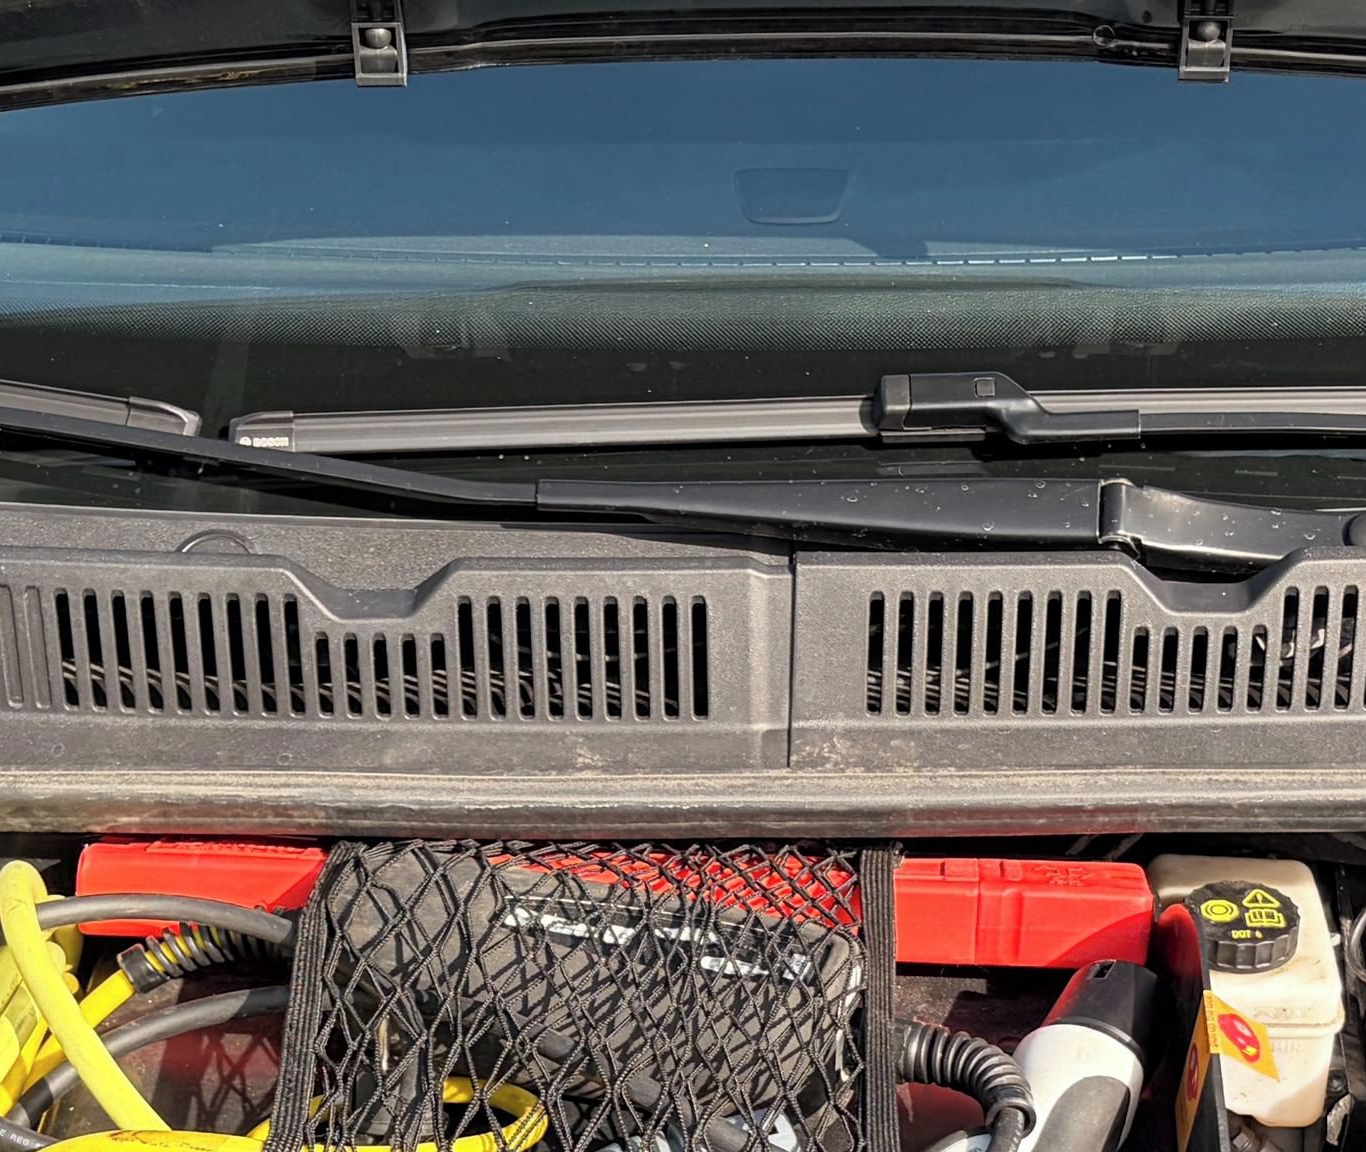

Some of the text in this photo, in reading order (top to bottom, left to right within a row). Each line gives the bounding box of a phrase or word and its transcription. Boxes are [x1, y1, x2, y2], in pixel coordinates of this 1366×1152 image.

[252, 436, 290, 448] BOSCH
[1231, 929, 1251, 939] DOT
[10, 1132, 30, 1146] REG
